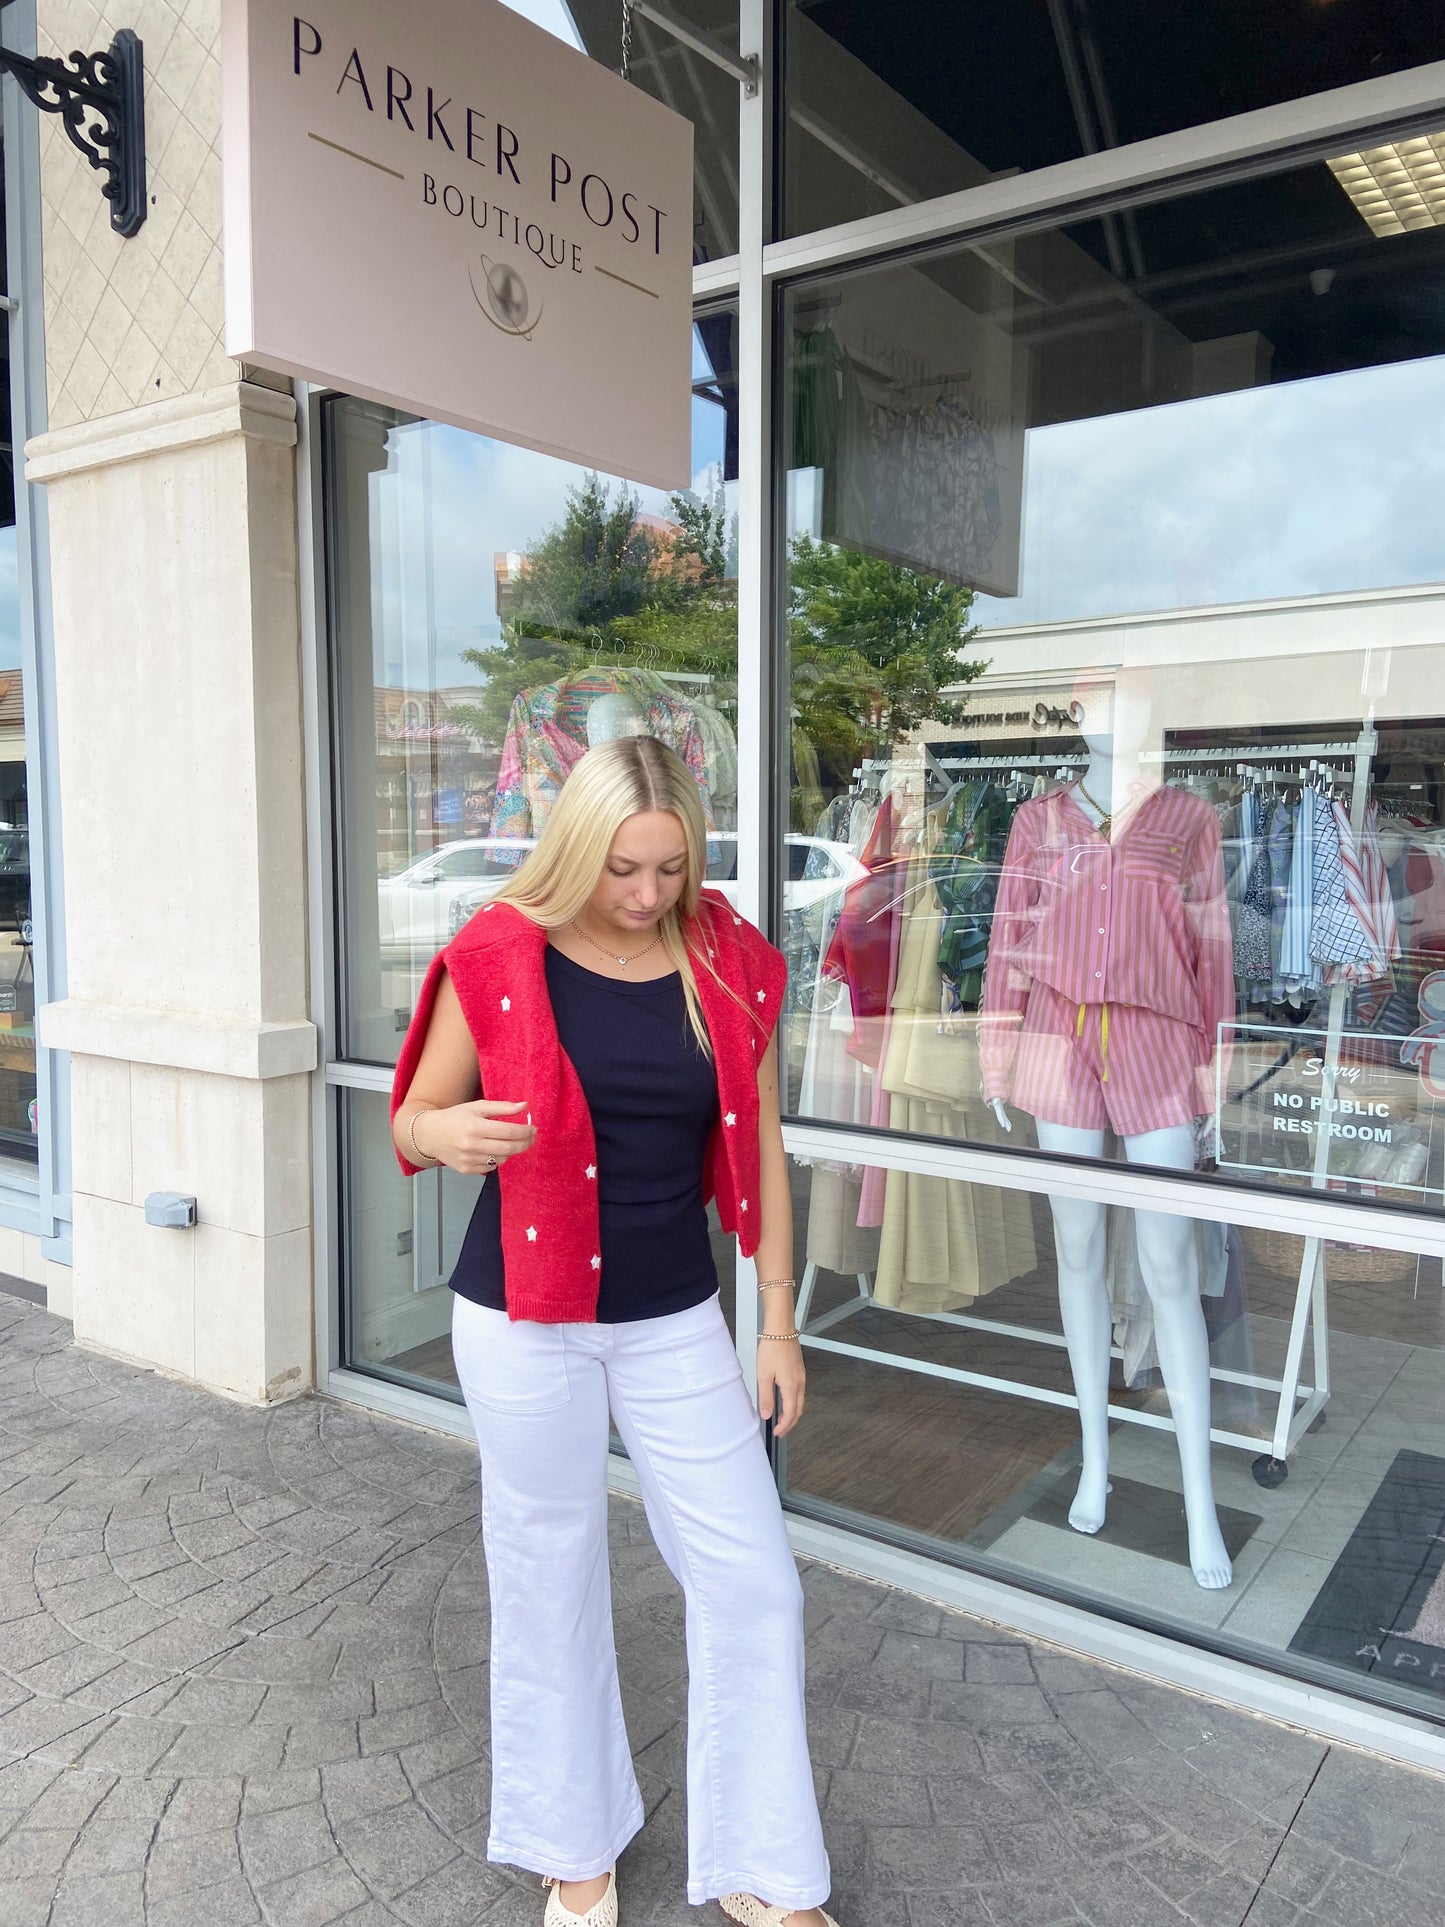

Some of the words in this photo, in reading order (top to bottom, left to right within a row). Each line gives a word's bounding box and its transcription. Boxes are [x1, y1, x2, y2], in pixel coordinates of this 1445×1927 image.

[293, 16, 521, 184] PARKER
[551, 152, 668, 255] POST
[422, 173, 583, 273] BOUTIQUE
[1302, 1058, 1361, 1084] Sorry
[1273, 1092, 1304, 1109] NO
[1310, 1096, 1390, 1118] PUBLIC
[1273, 1117, 1392, 1144] RESTROOM
